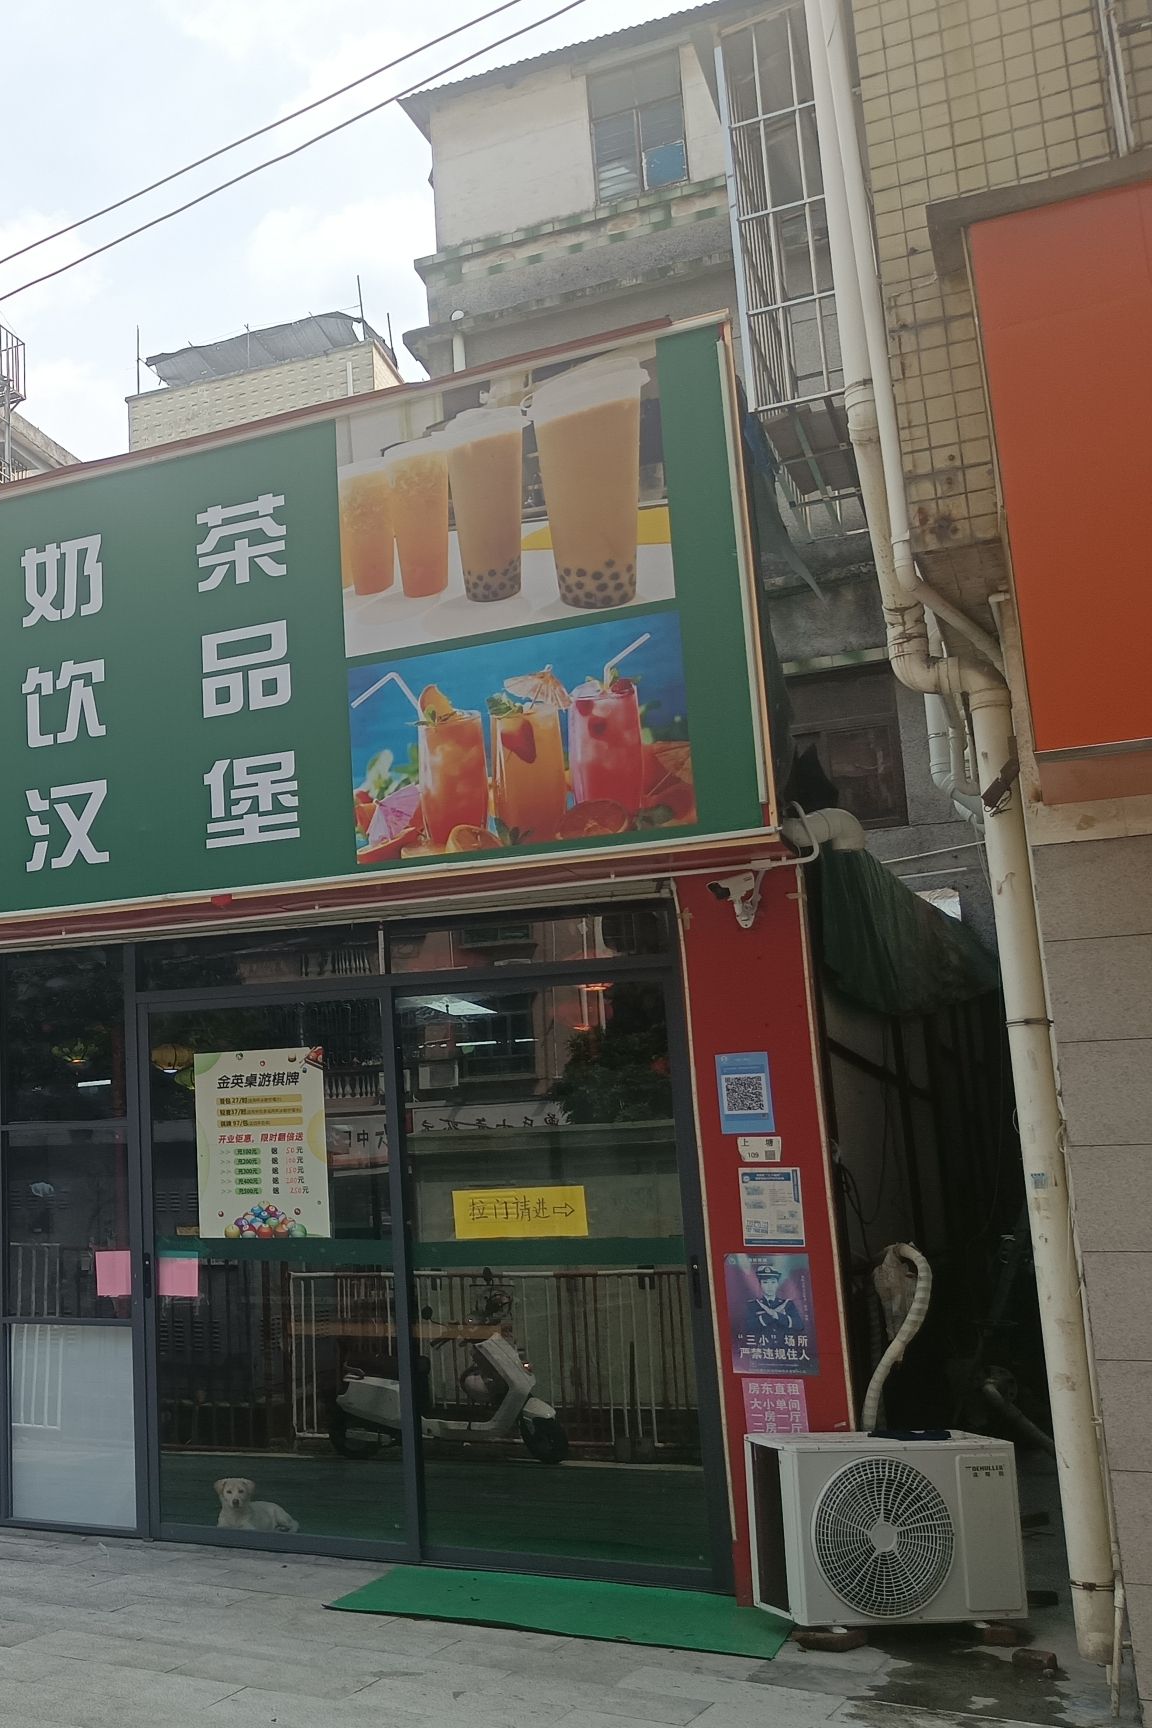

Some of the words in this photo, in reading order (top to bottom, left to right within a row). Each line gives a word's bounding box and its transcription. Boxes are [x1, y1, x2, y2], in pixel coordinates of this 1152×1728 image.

[20, 493, 287, 628] 奶茶
[22, 619, 291, 748] 饮品
[25, 750, 300, 872] 汉堡
[217, 1072, 299, 1089] 金英桌游棋牌
[469, 1195, 551, 1222] 拉门请进
[740, 1347, 810, 1361] 严禁违规住人
[748, 1383, 800, 1395] 房东直租
[750, 1399, 800, 1411] 大小单间
[751, 1411, 801, 1423] 一房一厅
[753, 1422, 802, 1434] 二房一厅
